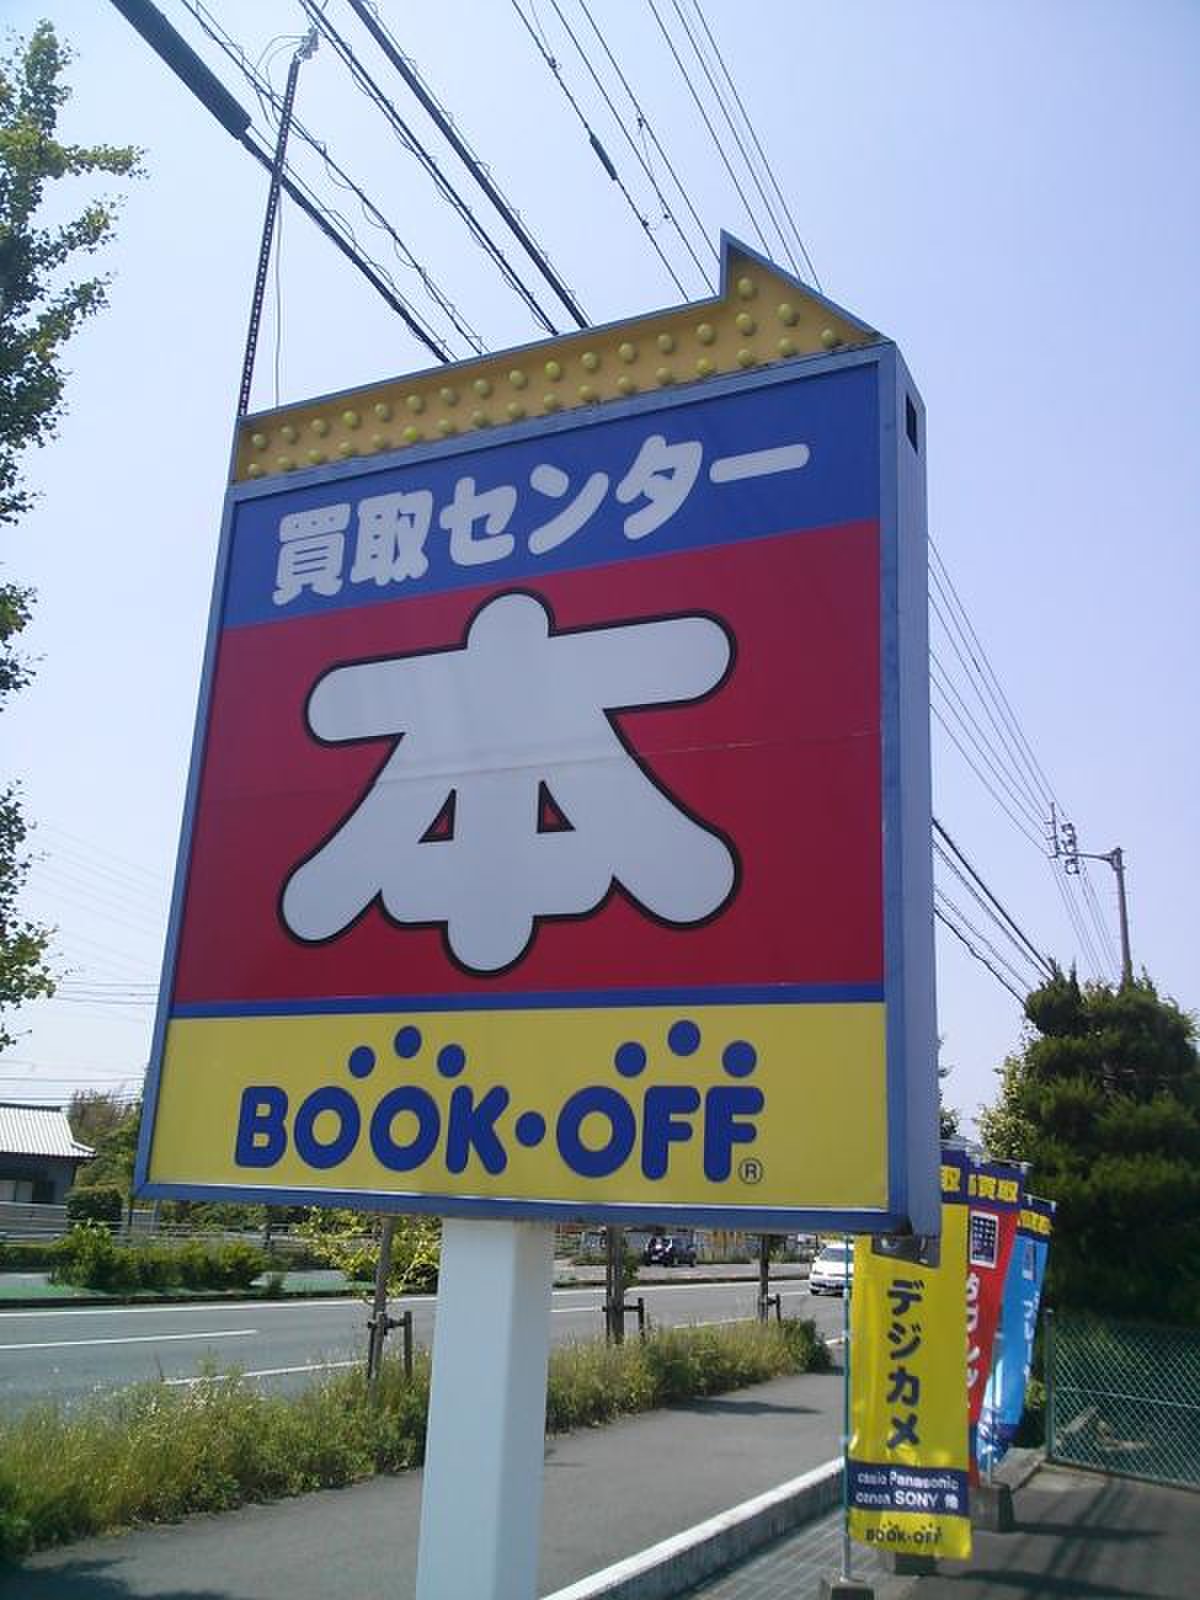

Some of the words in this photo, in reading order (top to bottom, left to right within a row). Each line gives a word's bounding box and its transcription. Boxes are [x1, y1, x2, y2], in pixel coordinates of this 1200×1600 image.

[272, 435, 809, 606] 買取センター
[280, 587, 742, 976] 本
[886, 1279, 925, 1449] デジカメ
[895, 1489, 938, 1507] SONY
